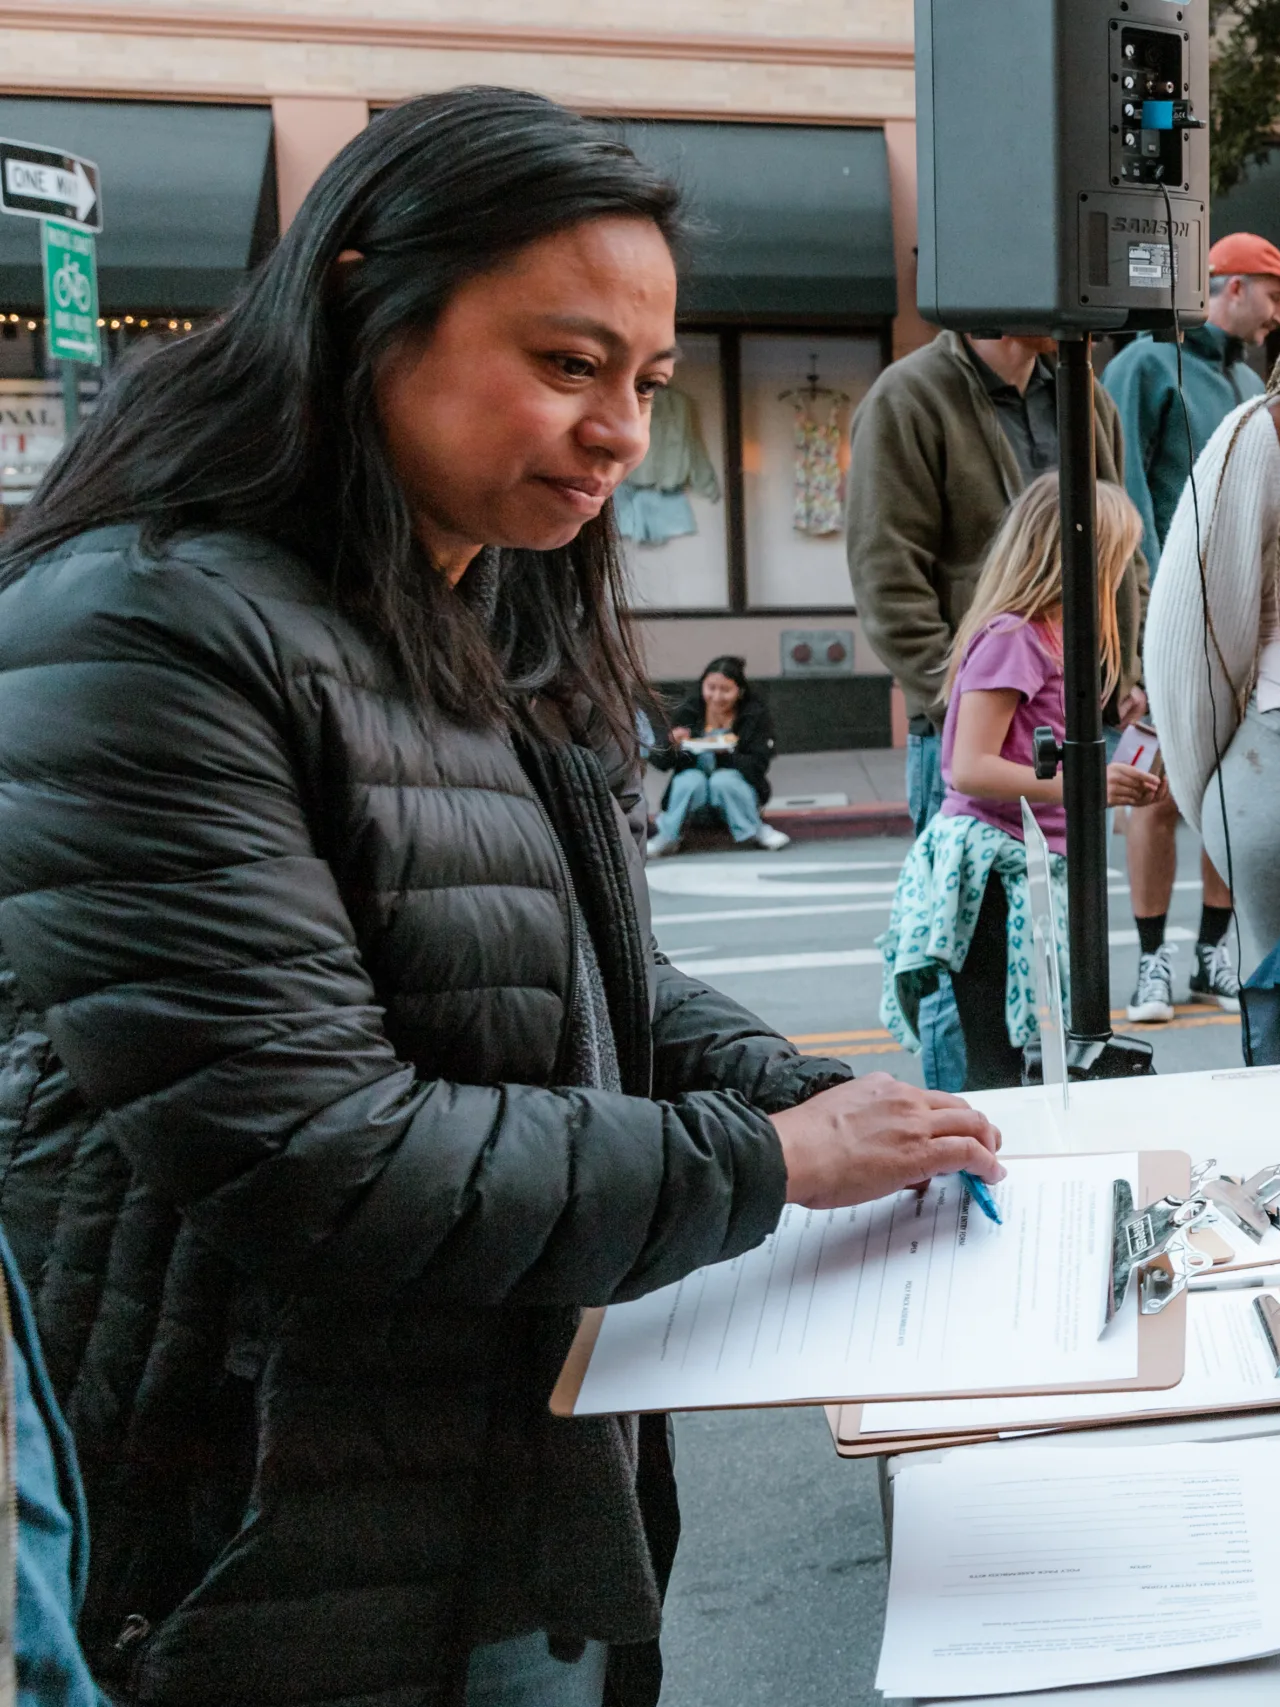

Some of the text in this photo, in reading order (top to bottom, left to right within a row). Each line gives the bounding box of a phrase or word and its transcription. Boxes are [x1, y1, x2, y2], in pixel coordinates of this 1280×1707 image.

[13, 167, 48, 193] ONE
[1111, 216, 1190, 237] SAMSON
[0, 409, 55, 427] NAL
